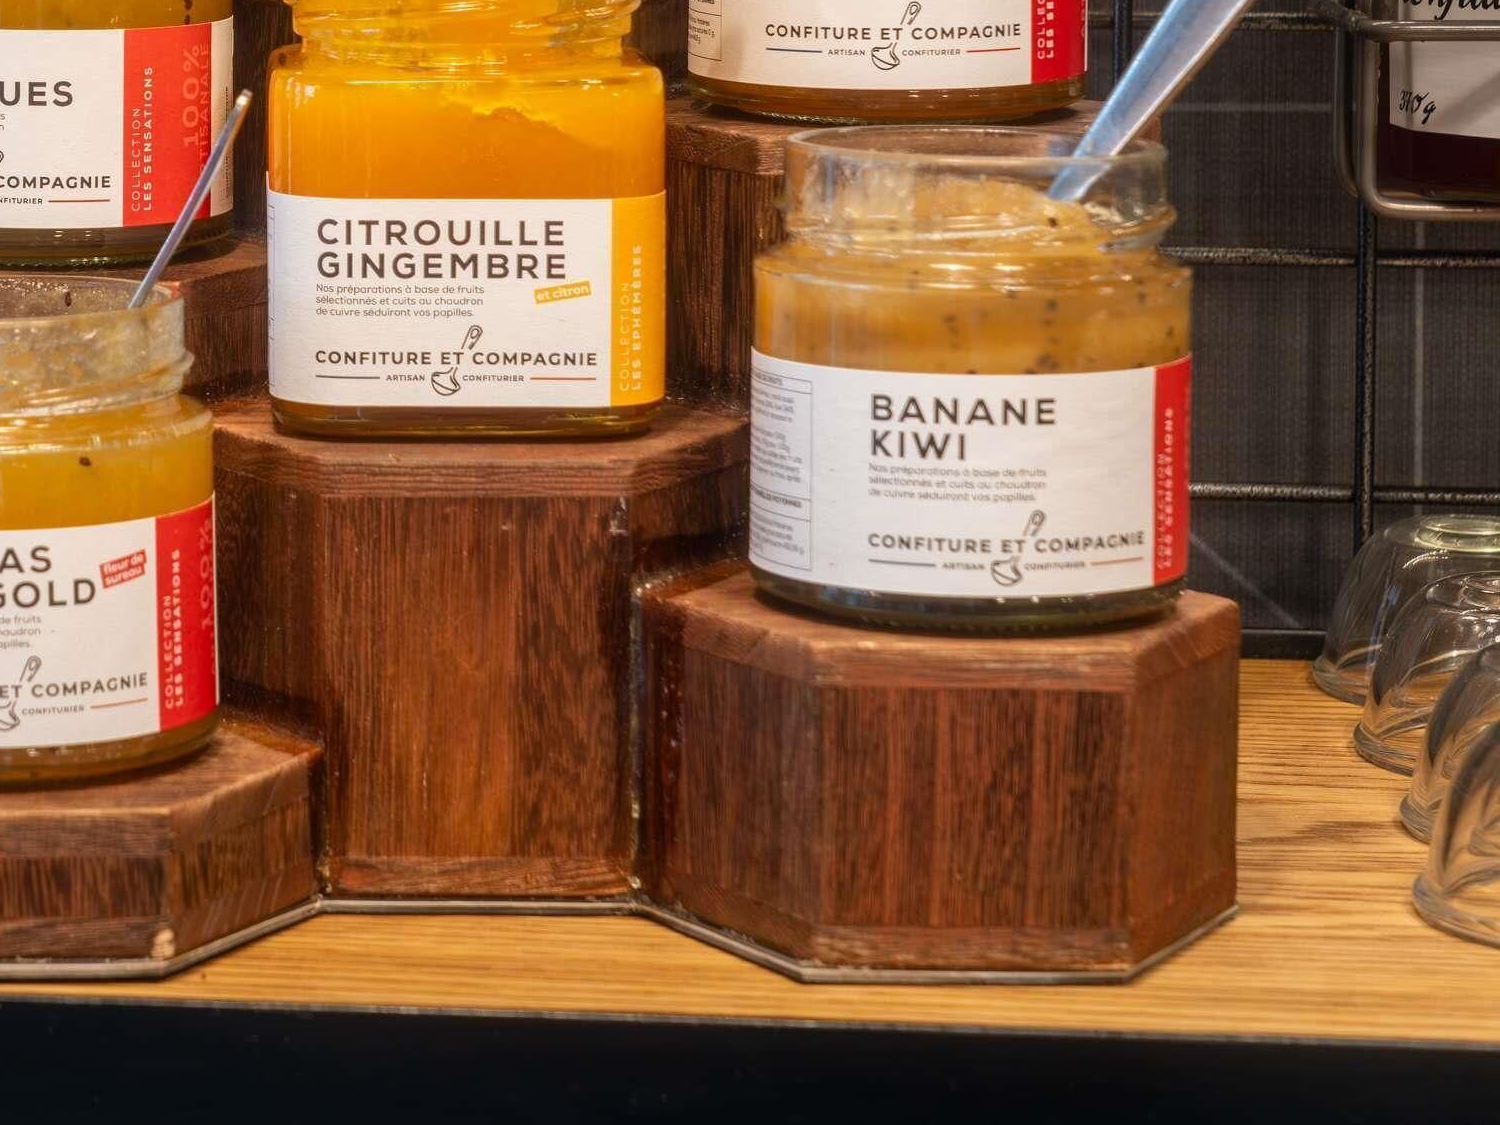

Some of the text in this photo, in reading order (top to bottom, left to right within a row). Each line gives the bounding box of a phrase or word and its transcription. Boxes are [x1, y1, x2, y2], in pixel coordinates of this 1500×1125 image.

[765, 23, 1021, 40] CONFITURE ET COMPAGNIE
[144, 67, 155, 212] LES SENSATIONS
[131, 108, 140, 212] COLLECTION
[317, 218, 564, 247] CITROUILLE
[317, 252, 566, 279] GINGEMBRE
[315, 350, 597, 366] CONFITURE ET COMPAGNIE
[871, 393, 1057, 425] BANANE
[871, 429, 966, 461] KIWI
[868, 531, 1144, 553] CONFITURE ET COMPAGNIE
[31, 672, 148, 697] COMPAGNIE
